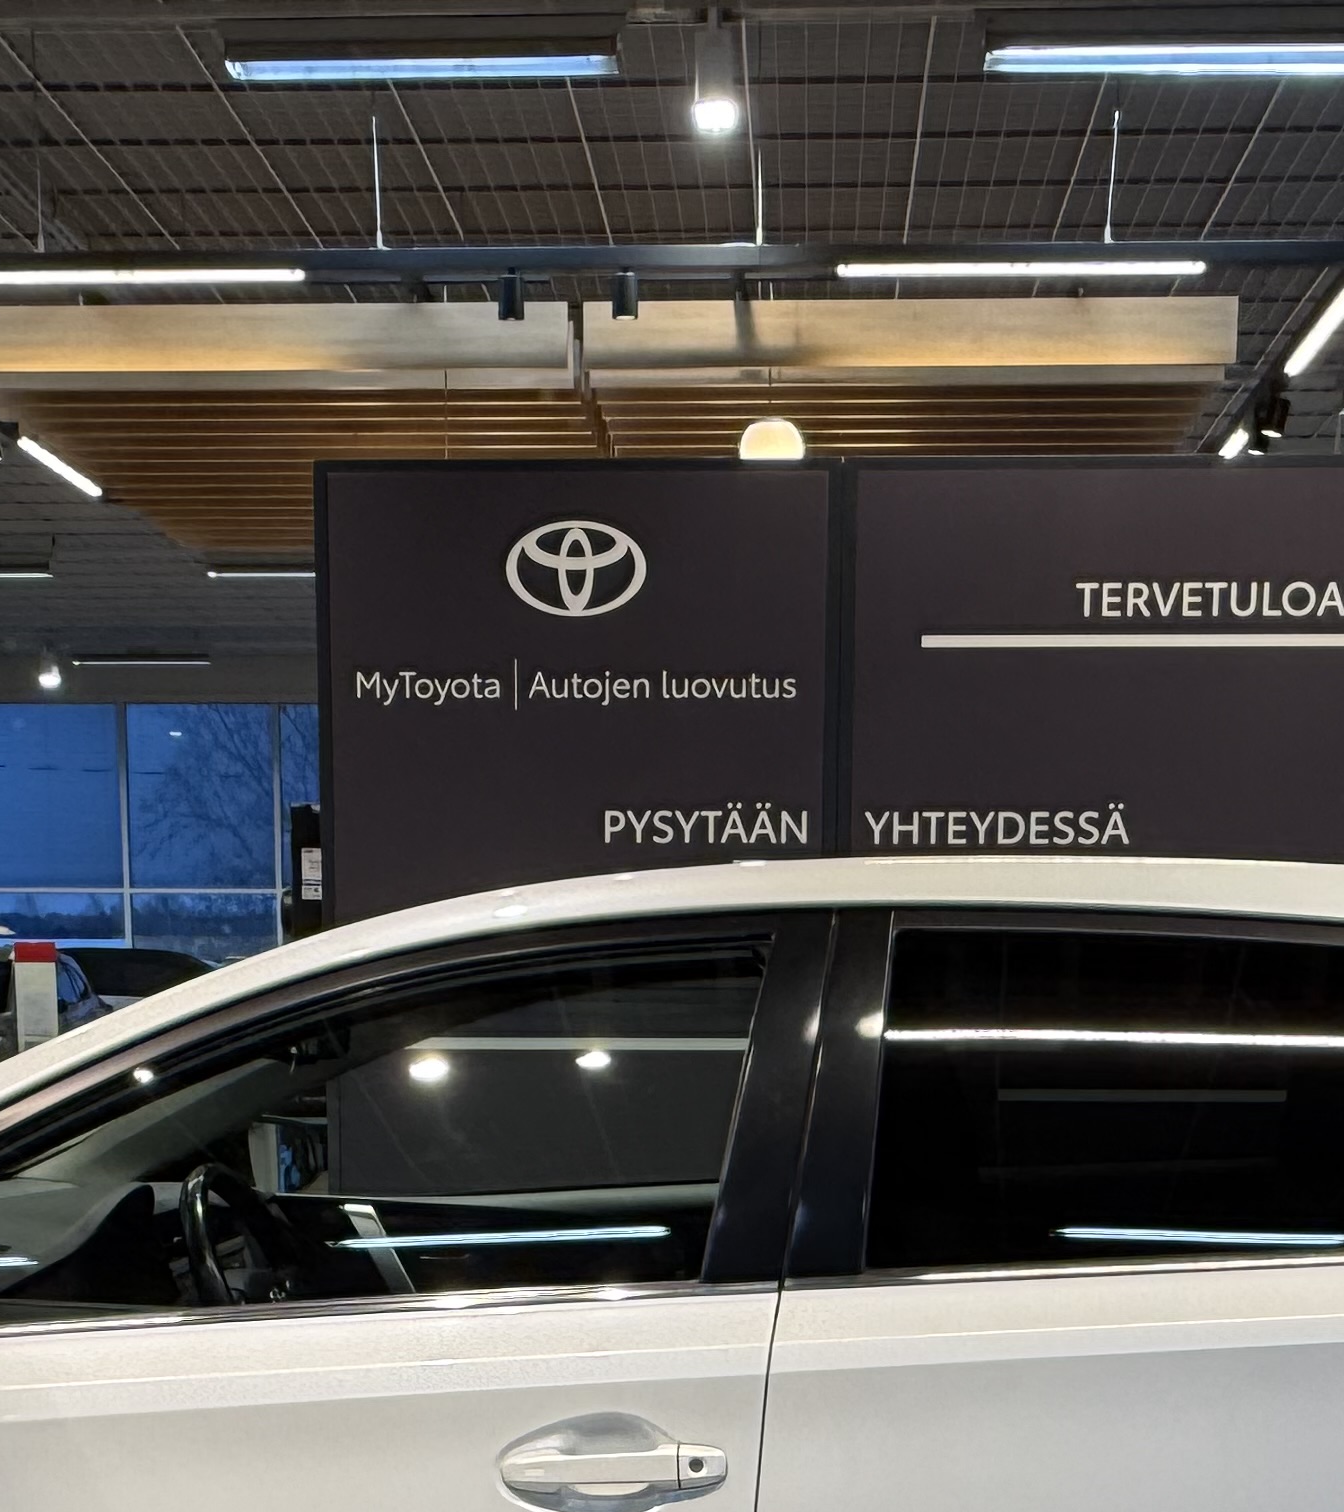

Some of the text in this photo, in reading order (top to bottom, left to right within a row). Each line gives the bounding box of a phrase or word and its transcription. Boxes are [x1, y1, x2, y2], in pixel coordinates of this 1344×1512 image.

[355, 670, 797, 706] MyToyota Autojen luovutus
[603, 801, 1131, 845] PYSYTÄÄN YHTEYDESSÄ
